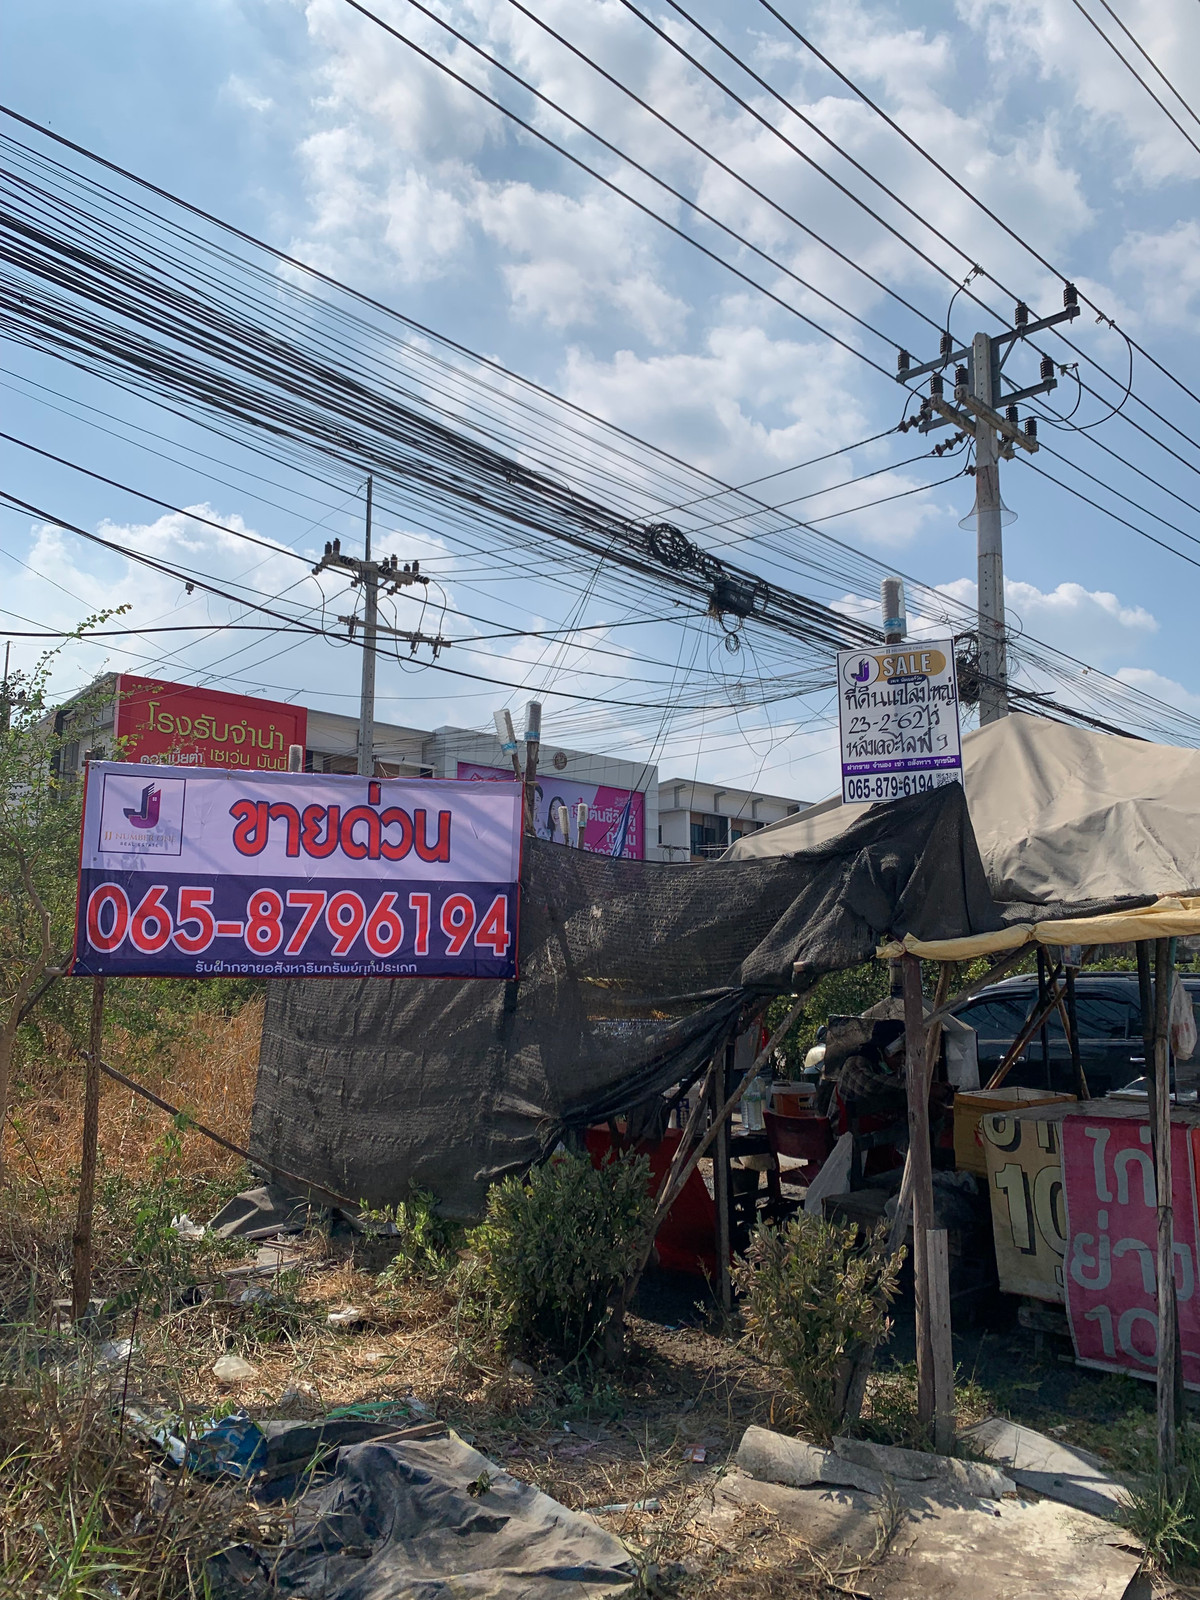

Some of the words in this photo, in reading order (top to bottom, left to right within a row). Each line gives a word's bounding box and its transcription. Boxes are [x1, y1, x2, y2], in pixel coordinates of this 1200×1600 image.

[883, 653, 932, 676] SALE
[148, 701, 285, 751] โรงรับจำนำ
[210, 749, 250, 766] เซเว่น
[257, 753, 287, 771] มันนี่
[848, 773, 935, 800] 065-879-6194
[105, 831, 113, 841] JJ
[115, 833, 154, 842] NUMBER
[229, 781, 451, 863] ขายด่วน
[86, 881, 511, 957] 065-8796194
[1085, 1126, 1158, 1207] ไก่
[1070, 1210, 1195, 1301] ย่าง
[1085, 1304, 1159, 1367] 10
